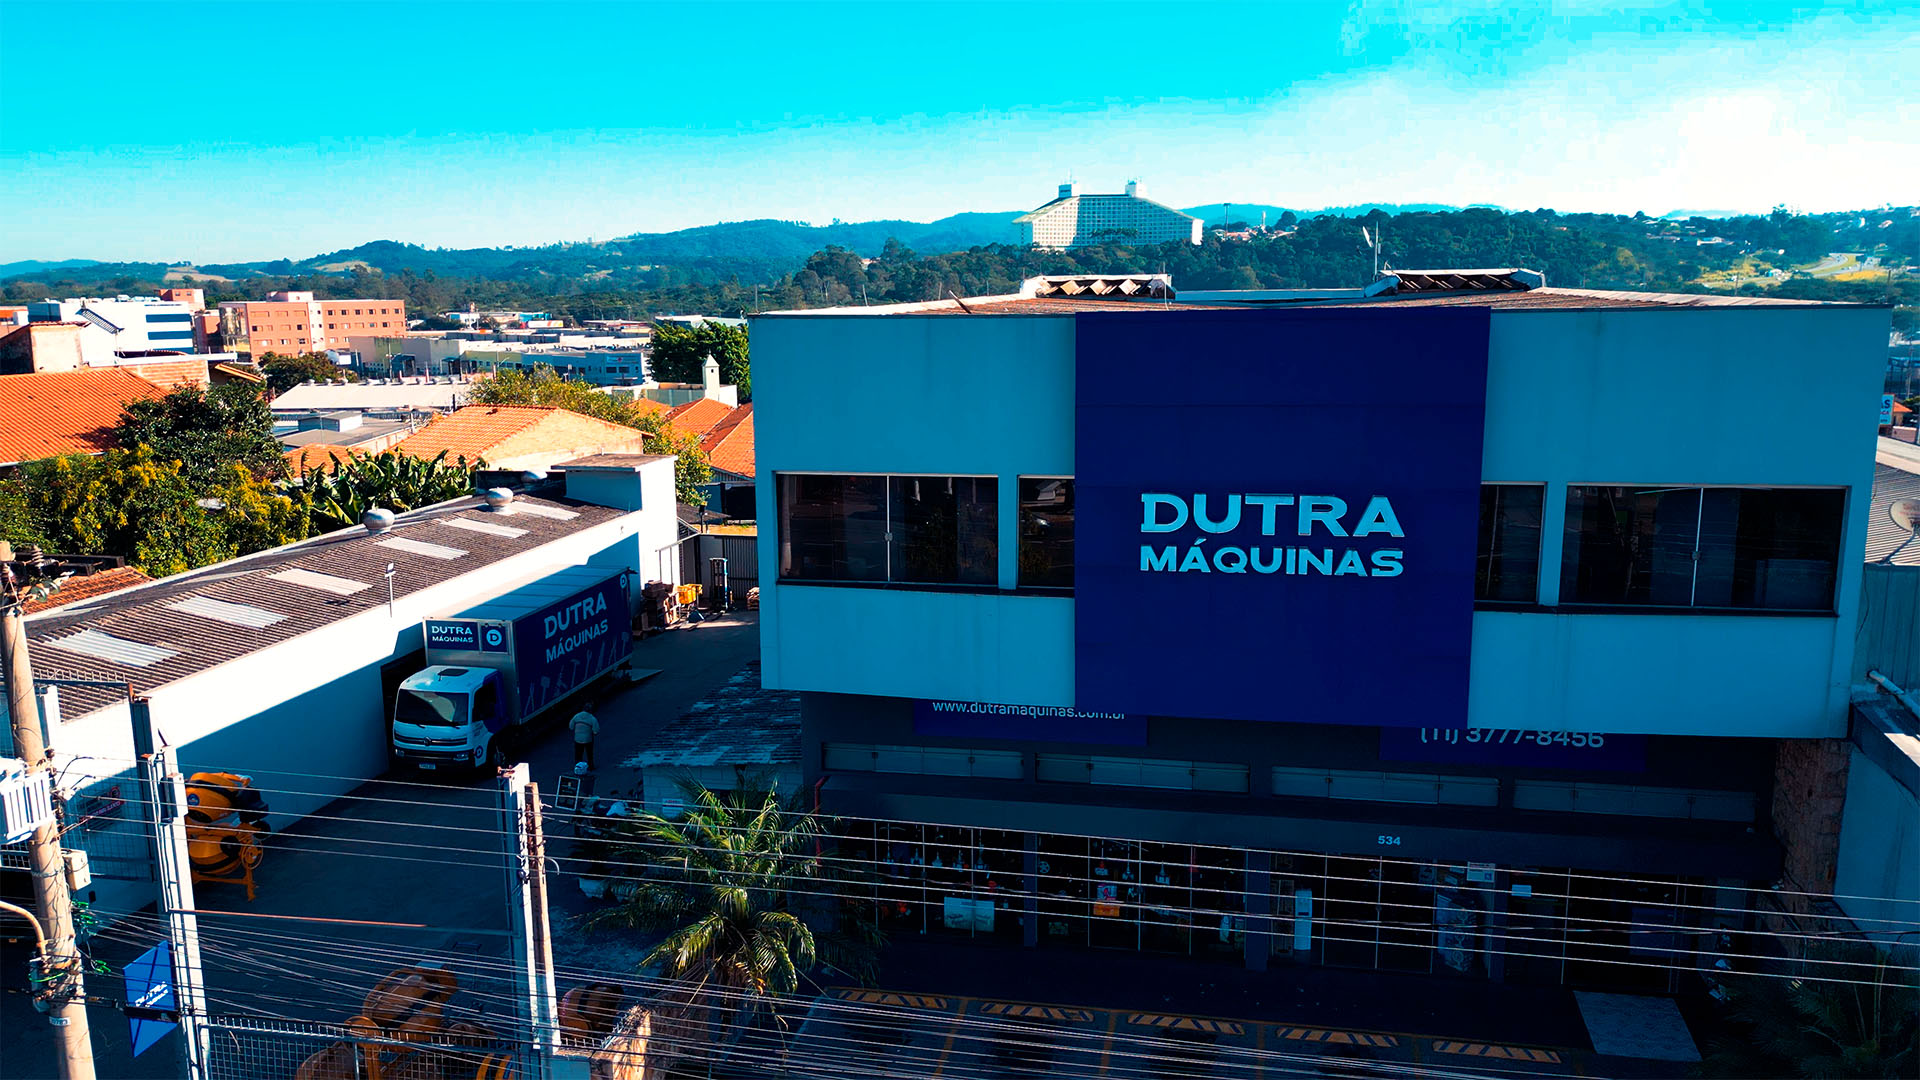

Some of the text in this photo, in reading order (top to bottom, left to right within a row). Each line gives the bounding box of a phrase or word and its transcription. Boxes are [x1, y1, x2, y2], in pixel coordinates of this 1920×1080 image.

[1141, 493, 1405, 537] DUTRA
[1140, 537, 1404, 577] MÁQUINAS
[431, 625, 473, 635] DUTRA
[544, 591, 608, 639] DUTRA
[432, 634, 474, 643] MÁQUINAS
[545, 618, 608, 664] MÁQUINAS
[1466, 728, 1604, 748] 3777-8456
[1378, 835, 1401, 846] 534
